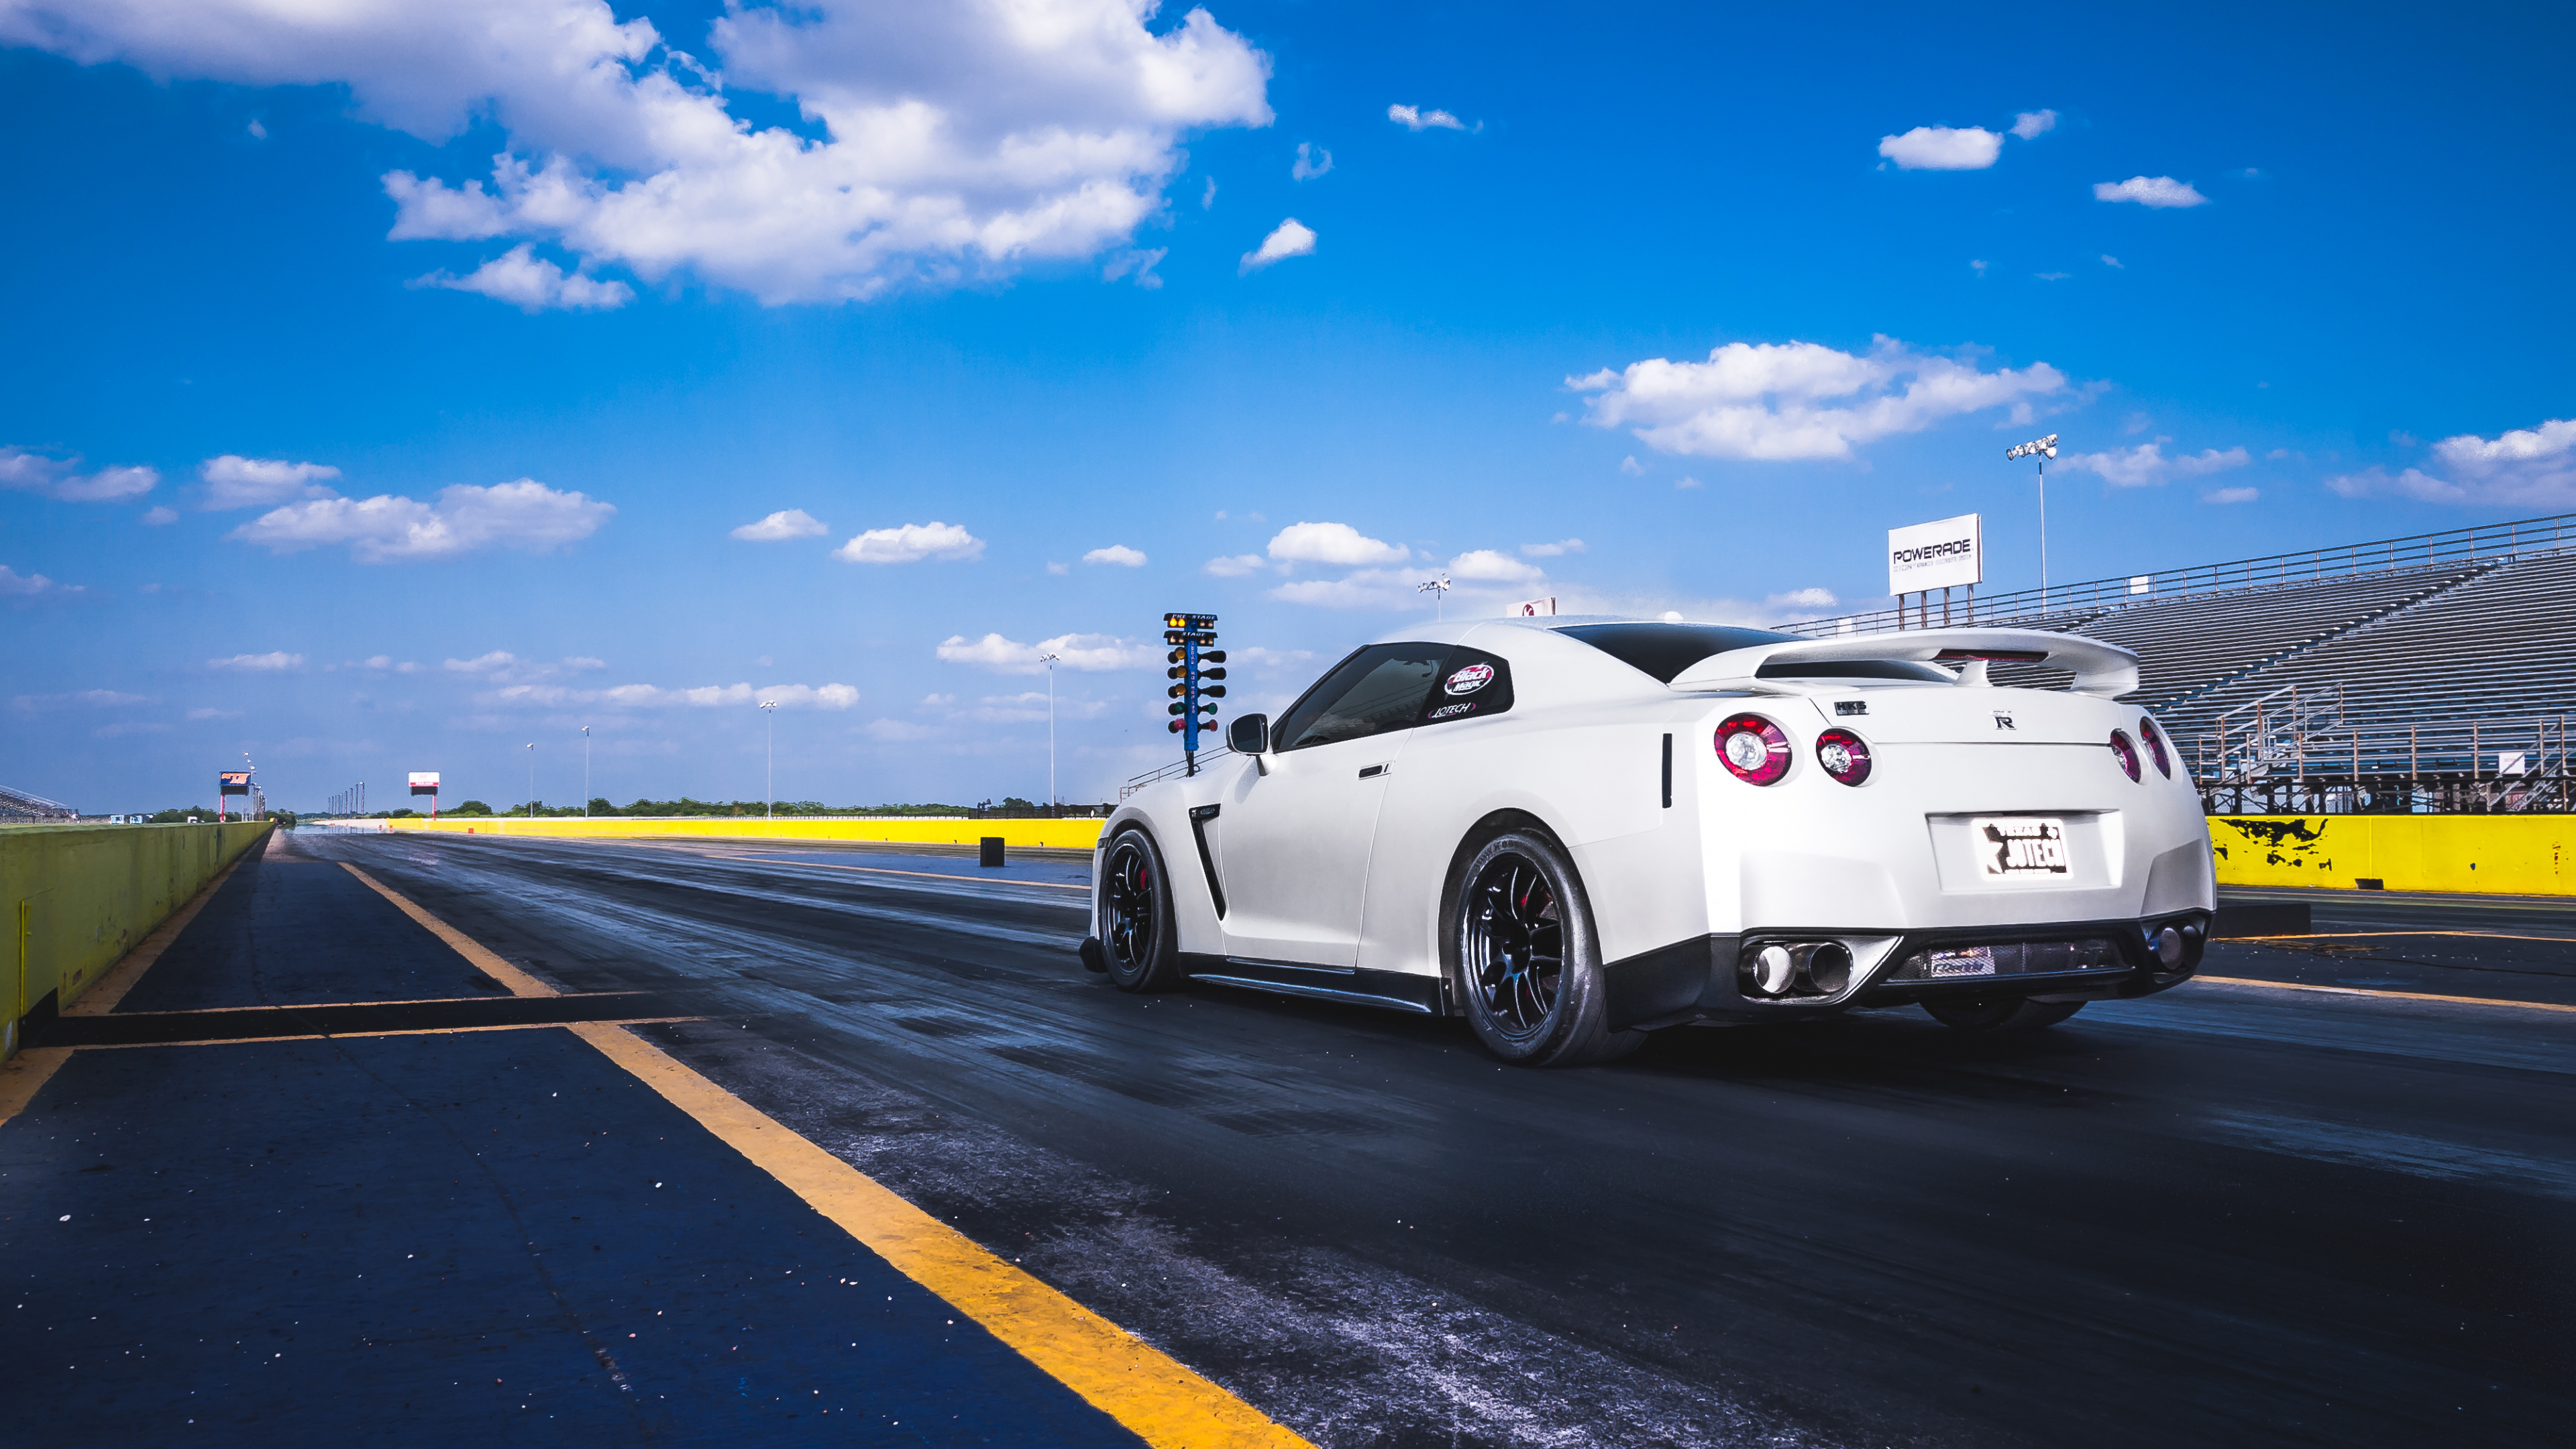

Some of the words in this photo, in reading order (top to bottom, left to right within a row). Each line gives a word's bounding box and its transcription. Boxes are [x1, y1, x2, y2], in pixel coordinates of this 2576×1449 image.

[1894, 539, 1971, 564] POWERADE
[1452, 667, 1490, 683] Black
[1453, 680, 1483, 692] Magic
[1836, 701, 1867, 711] HKS
[2006, 839, 2065, 867] JOTECH
